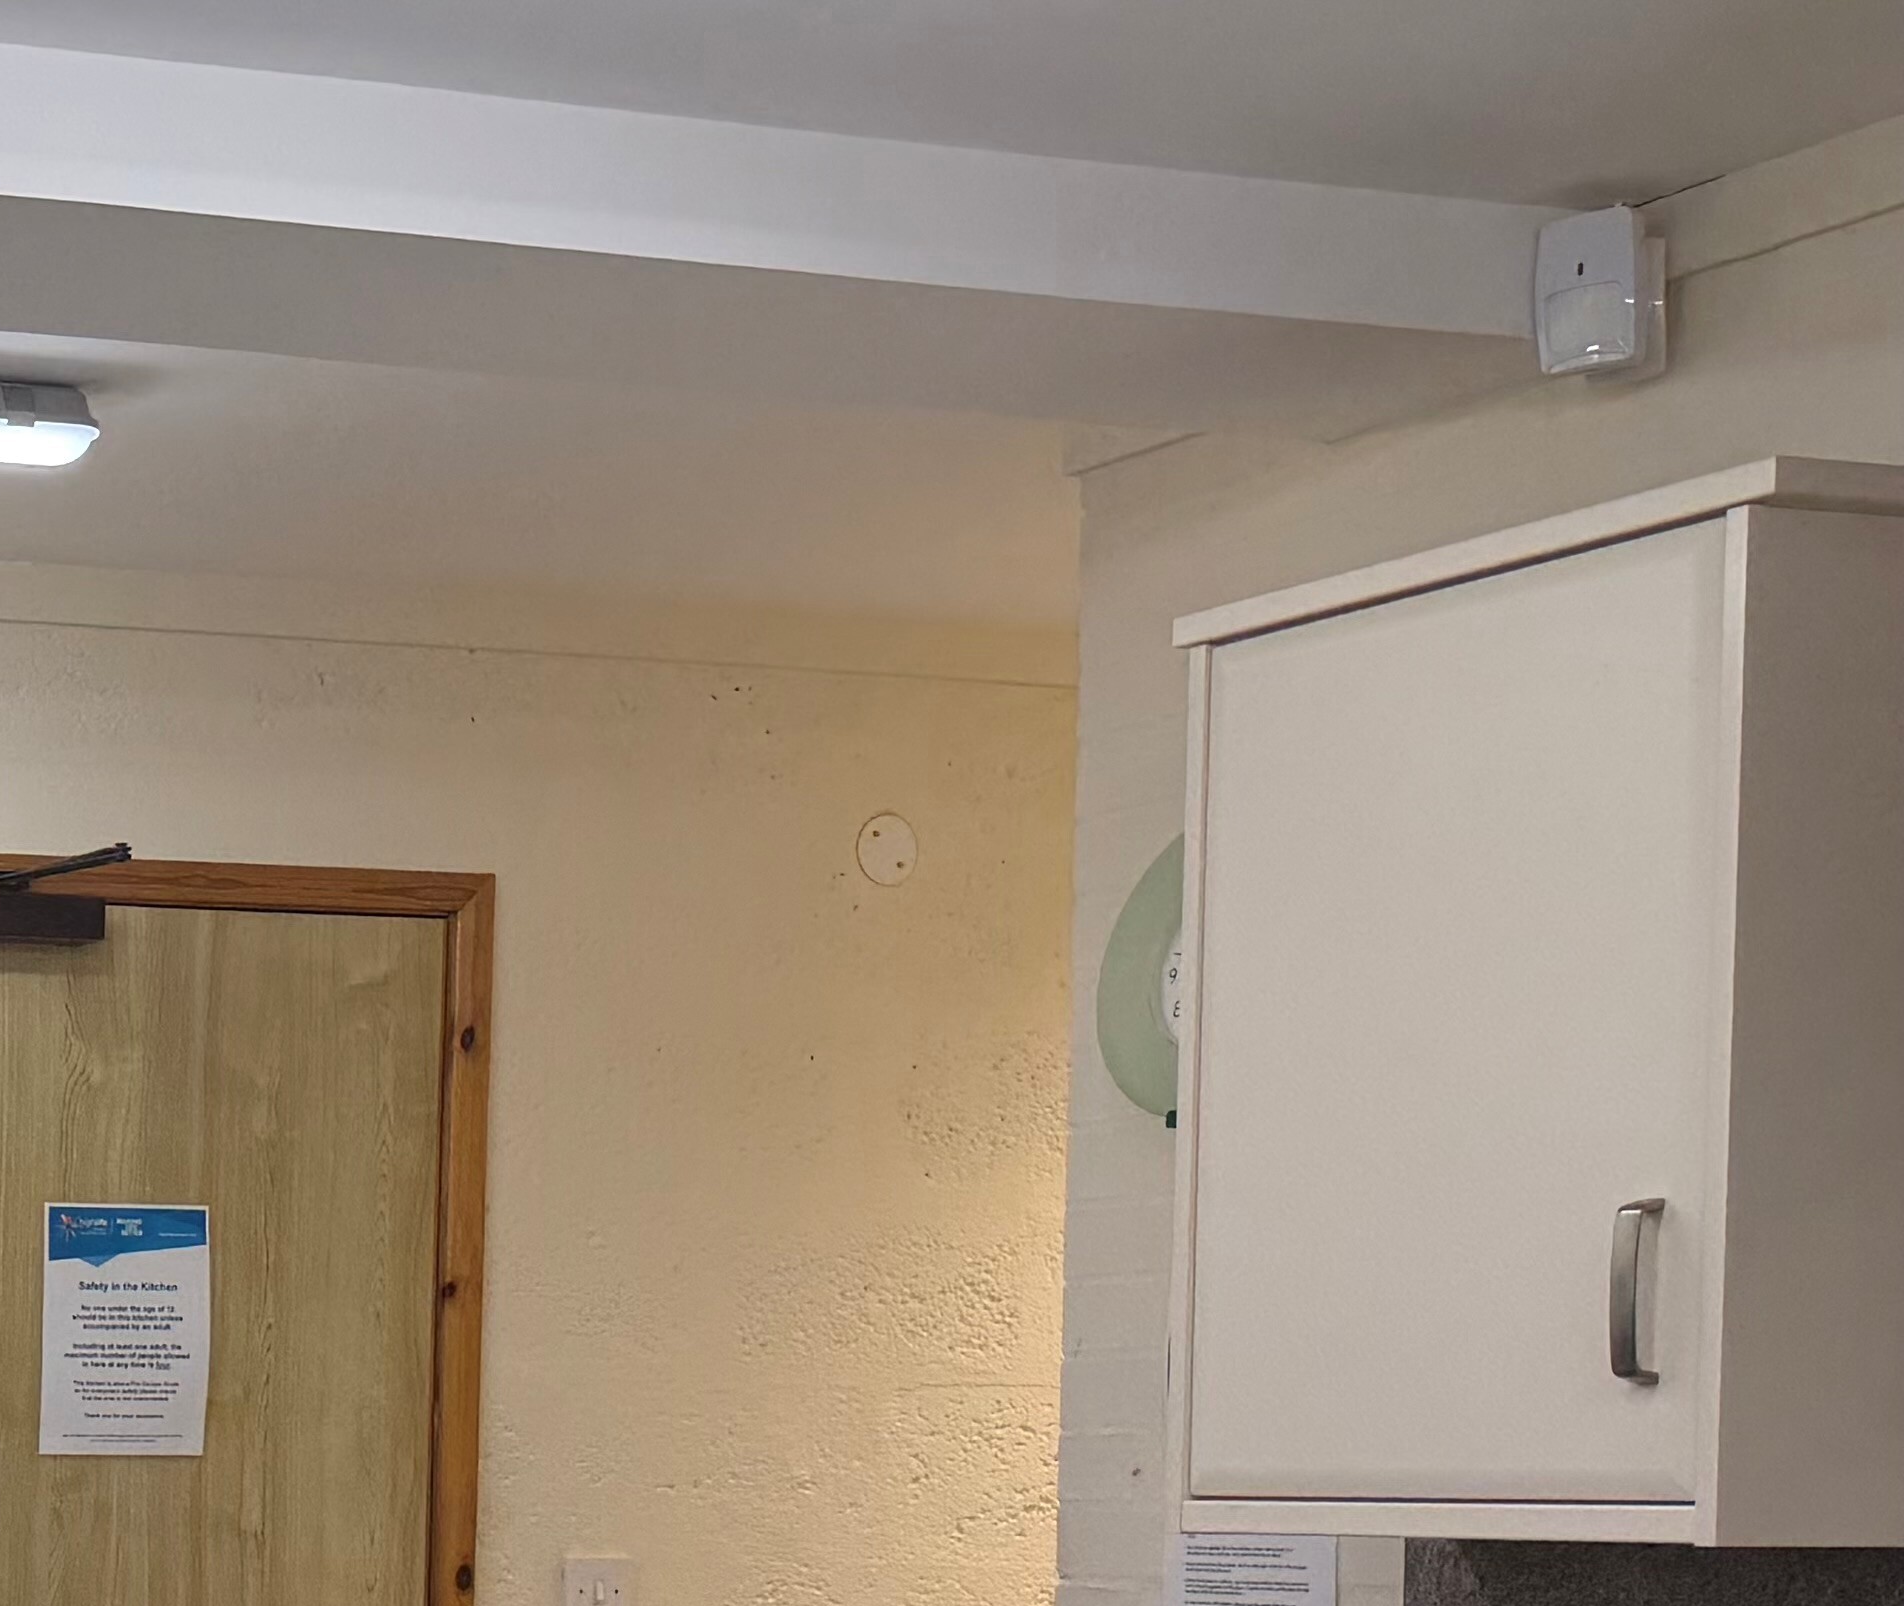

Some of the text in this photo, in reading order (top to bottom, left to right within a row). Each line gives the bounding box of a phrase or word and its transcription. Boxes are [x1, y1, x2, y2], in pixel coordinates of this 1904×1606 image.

[79, 1281, 178, 1293] Safety in the Kitchen
